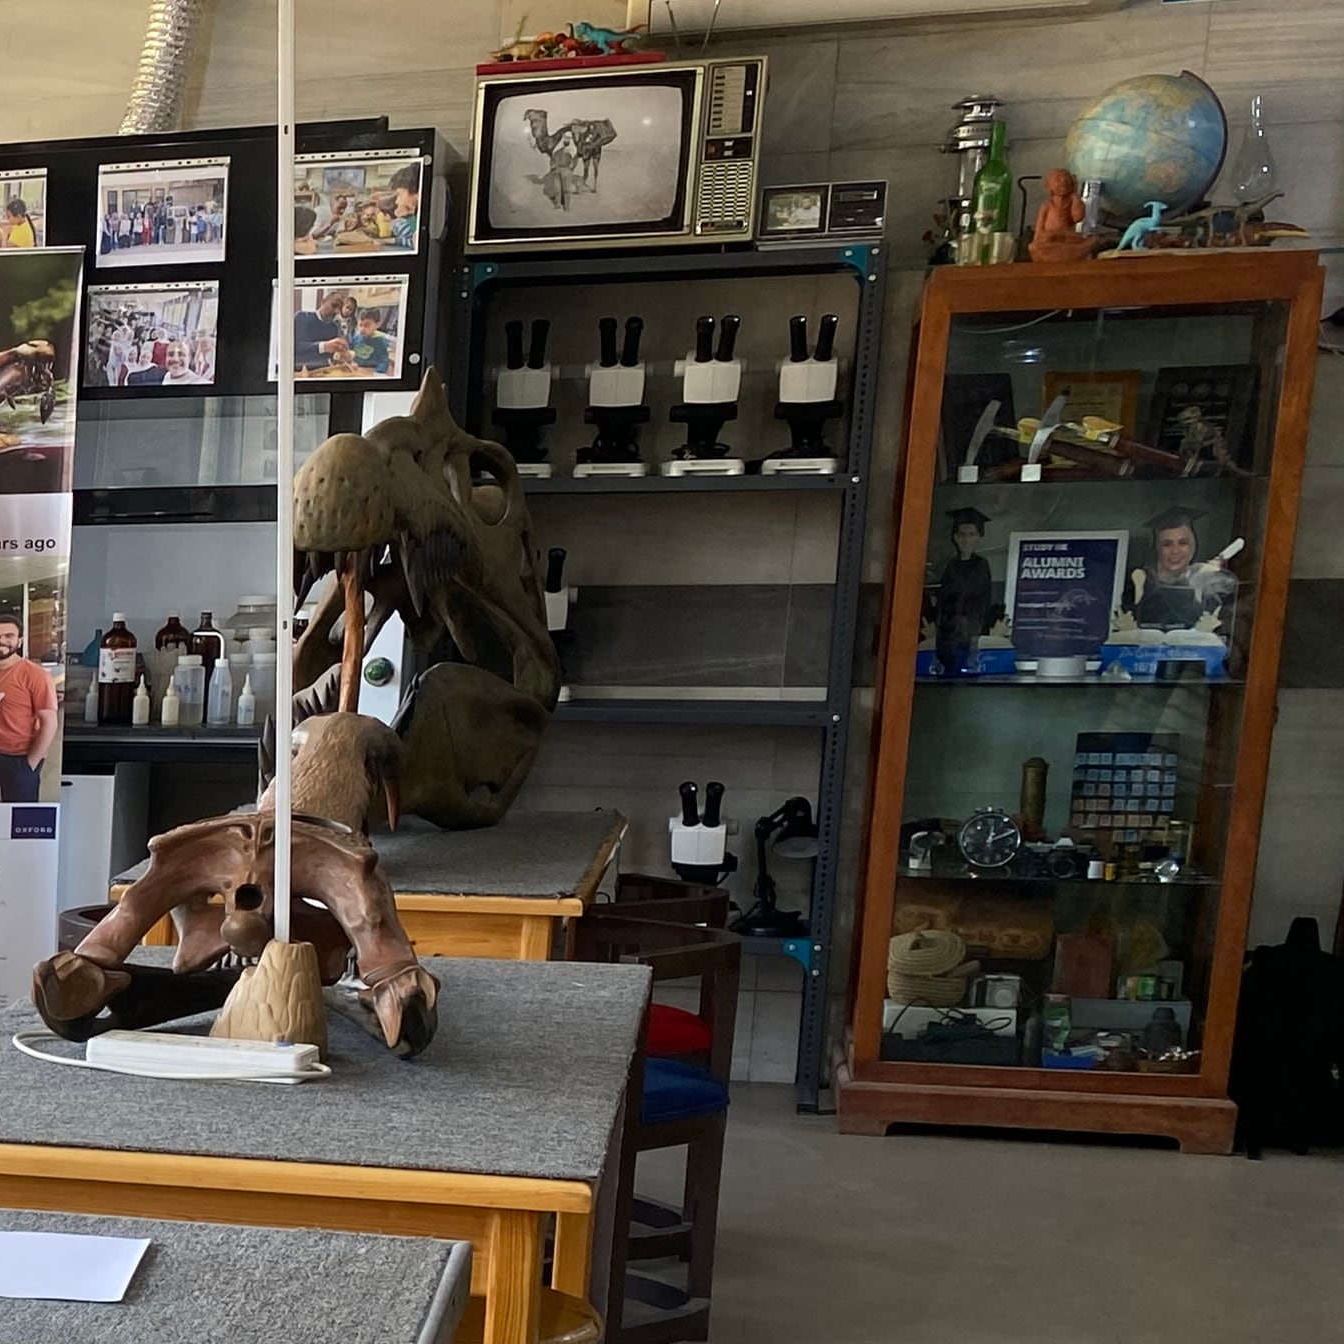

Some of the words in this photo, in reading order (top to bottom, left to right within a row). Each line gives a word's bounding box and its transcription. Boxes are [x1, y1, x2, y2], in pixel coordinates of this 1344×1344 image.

[24, 538, 56, 552] ago
[1022, 556, 1085, 568] ALUMNI
[1021, 568, 1086, 579] AWARDS
[15, 826, 53, 834] OXFORD
